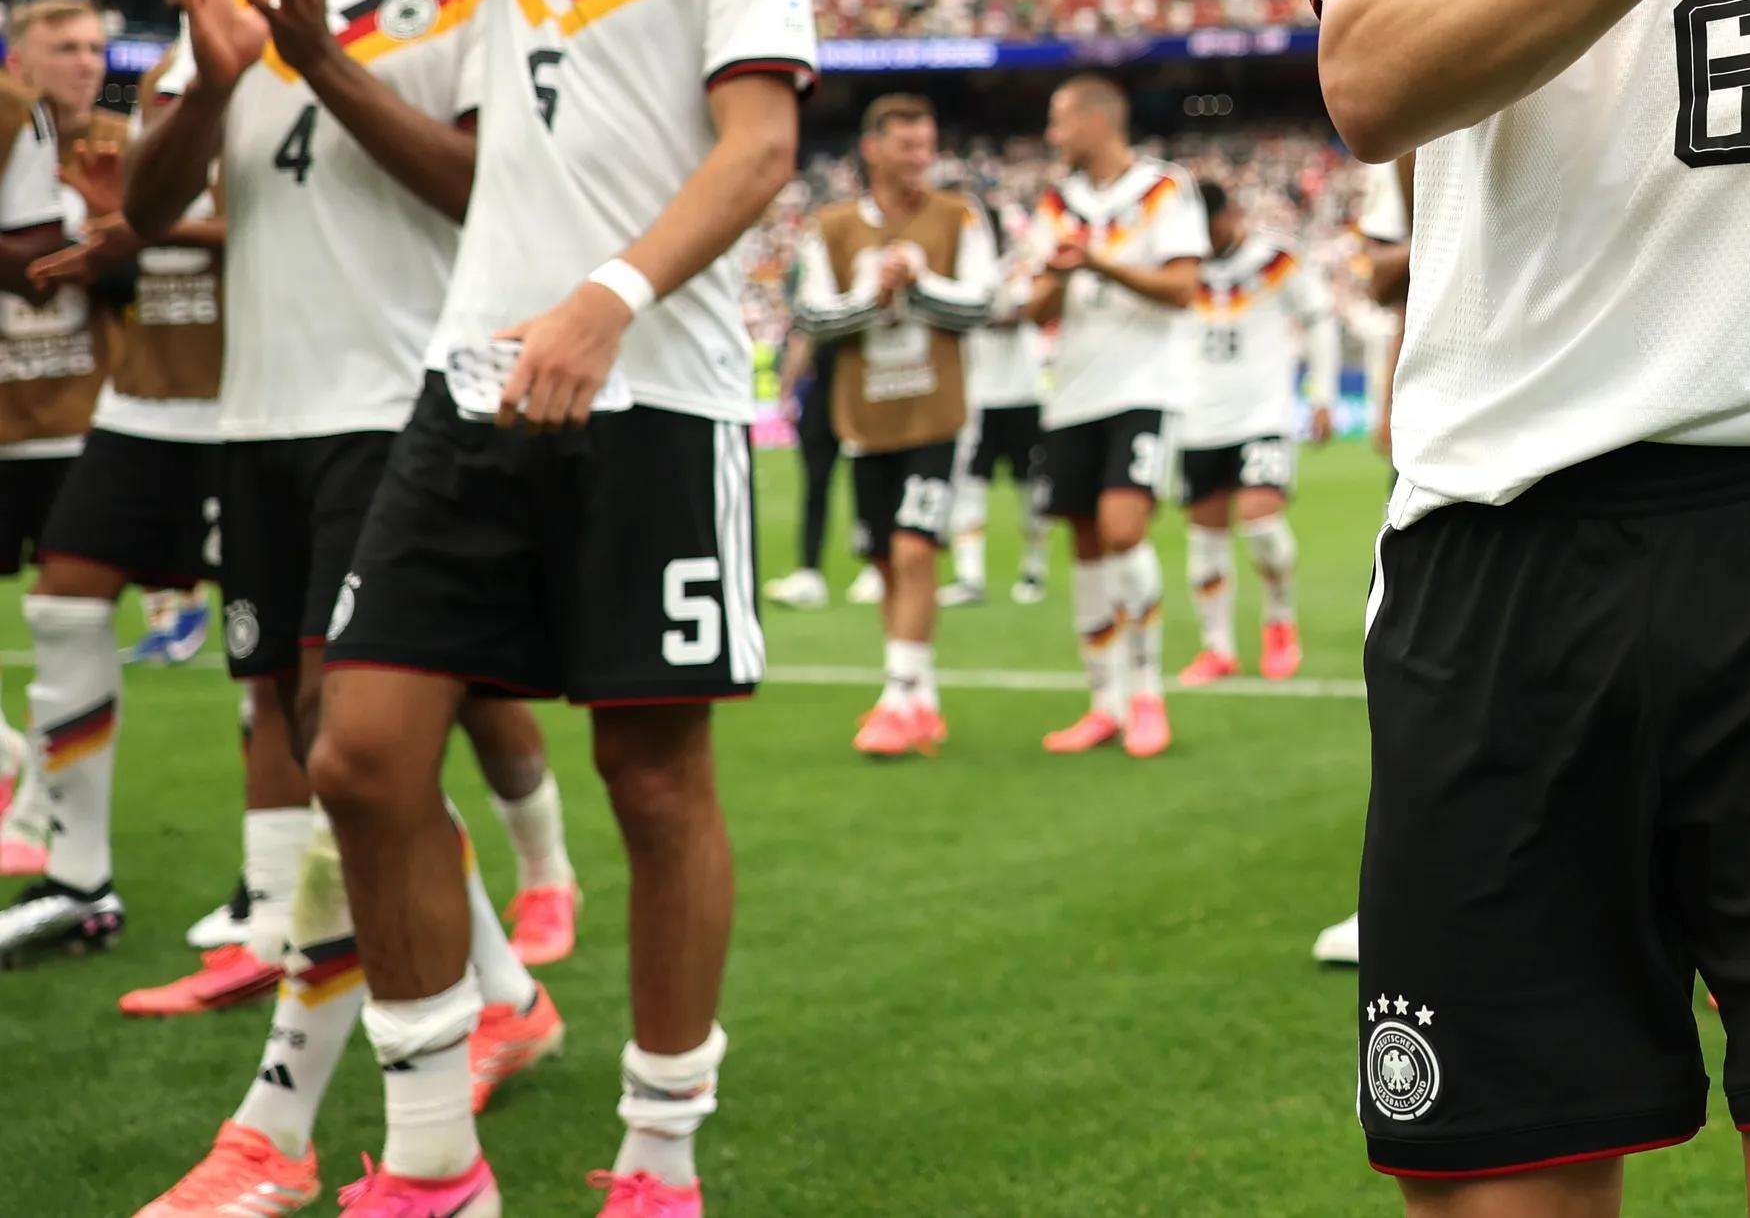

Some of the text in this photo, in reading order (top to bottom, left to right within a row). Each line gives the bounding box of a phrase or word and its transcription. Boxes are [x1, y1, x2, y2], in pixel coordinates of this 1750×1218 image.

[274, 103, 318, 186] 4
[661, 556, 723, 666] 5
[1375, 1034, 1416, 1053] DEUTSCHER
[1375, 1080, 1427, 1108] FUSSBALL-BUND
